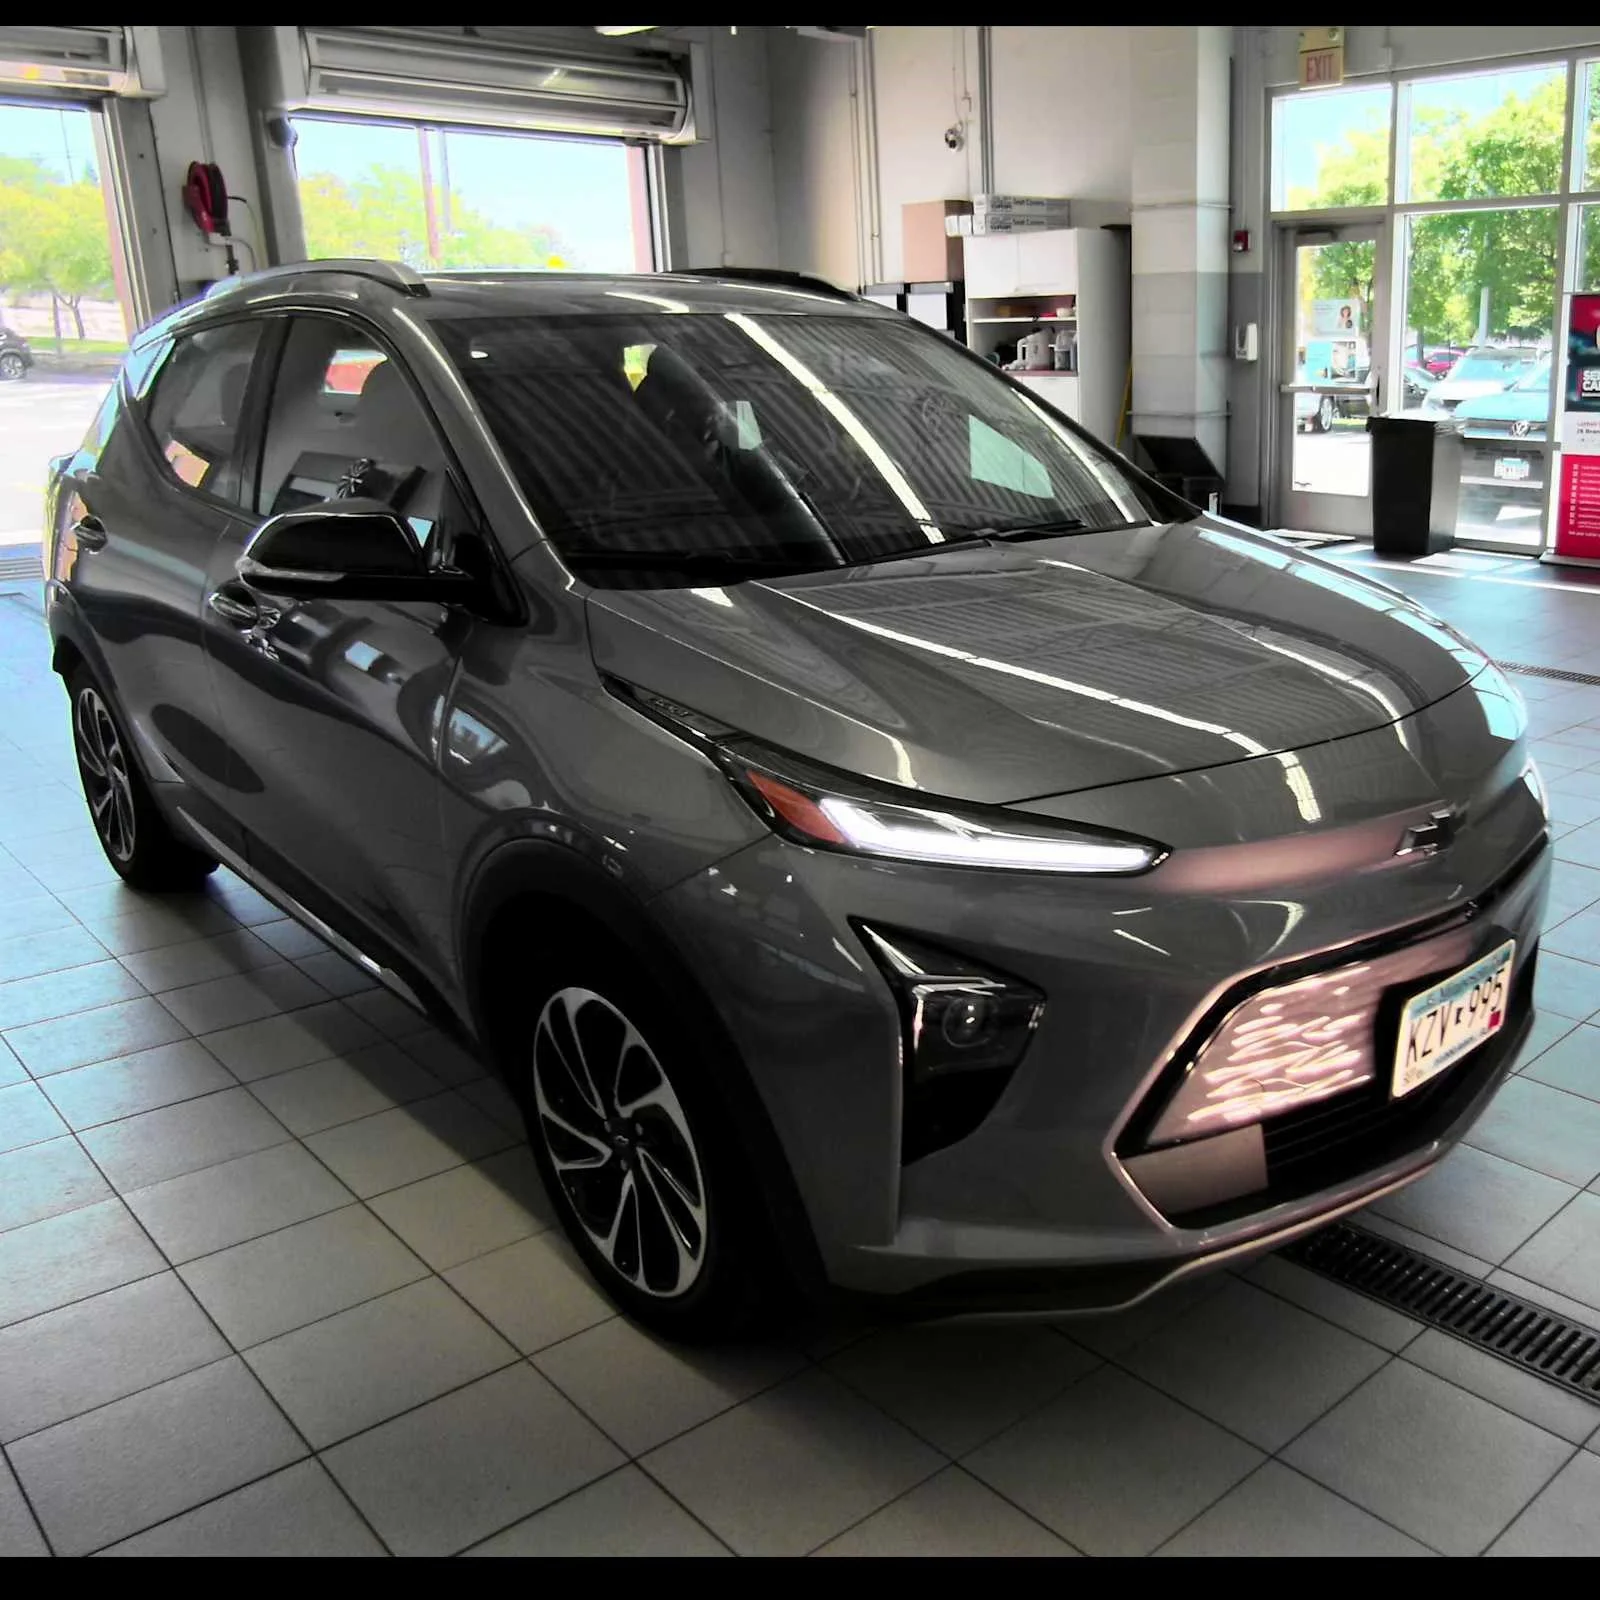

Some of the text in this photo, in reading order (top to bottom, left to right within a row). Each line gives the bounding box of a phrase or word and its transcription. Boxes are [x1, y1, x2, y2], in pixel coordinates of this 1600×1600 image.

[1307, 53, 1333, 81] EXIT
[1406, 1002, 1453, 1068] KZV
[1468, 968, 1505, 1028] 995
